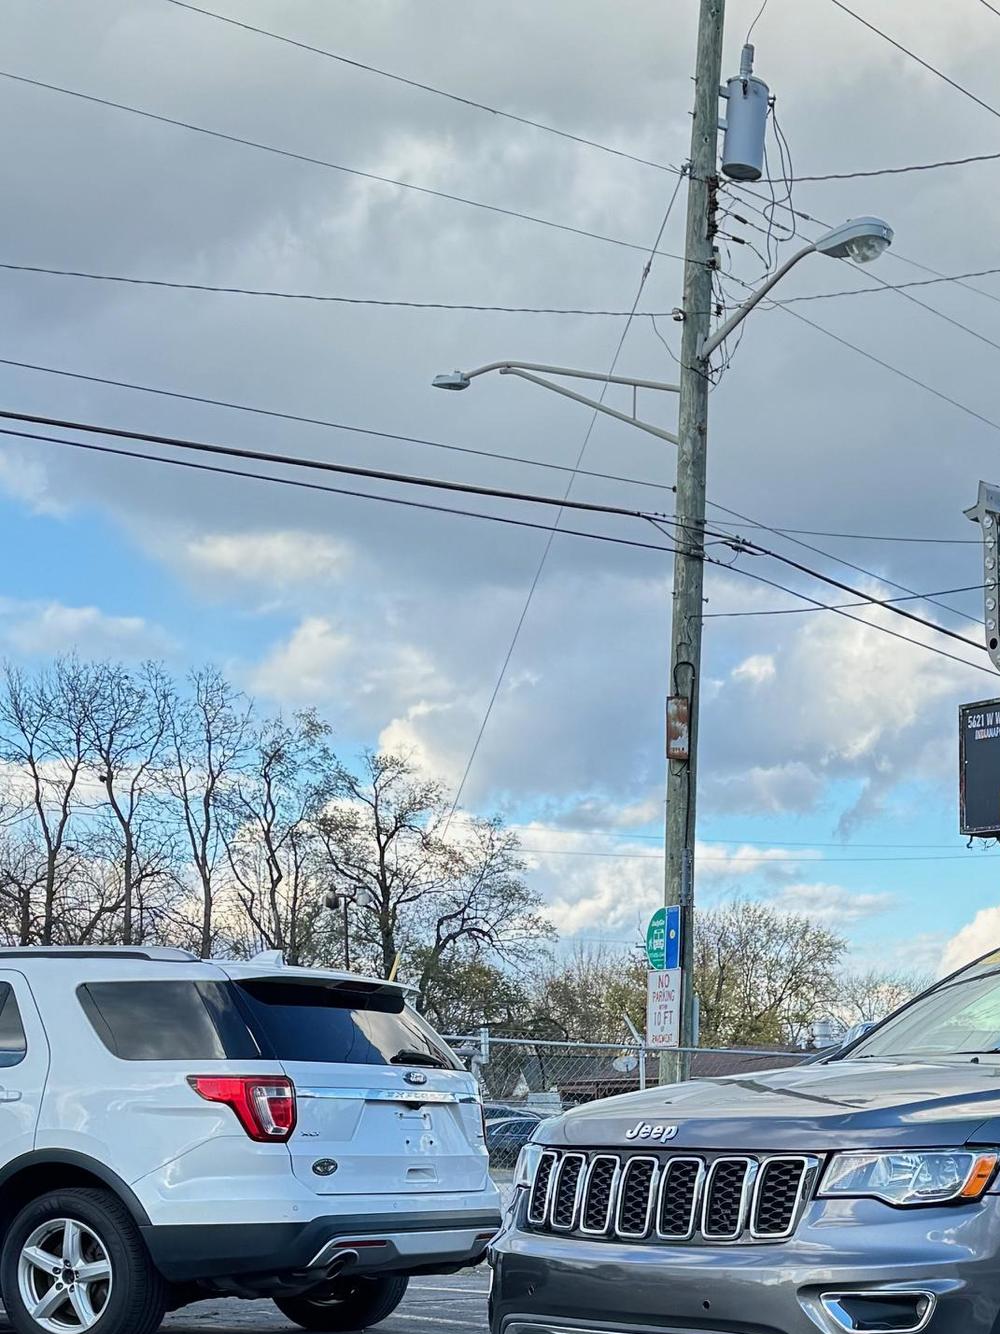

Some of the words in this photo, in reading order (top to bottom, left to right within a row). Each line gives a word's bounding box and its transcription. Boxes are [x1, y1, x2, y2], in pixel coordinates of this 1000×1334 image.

[967, 714, 984, 729] 5621
[986, 712, 994, 726] W
[658, 974, 670, 988] NO
[663, 1010, 673, 1025] FT
[625, 1120, 679, 1144] Jeep
